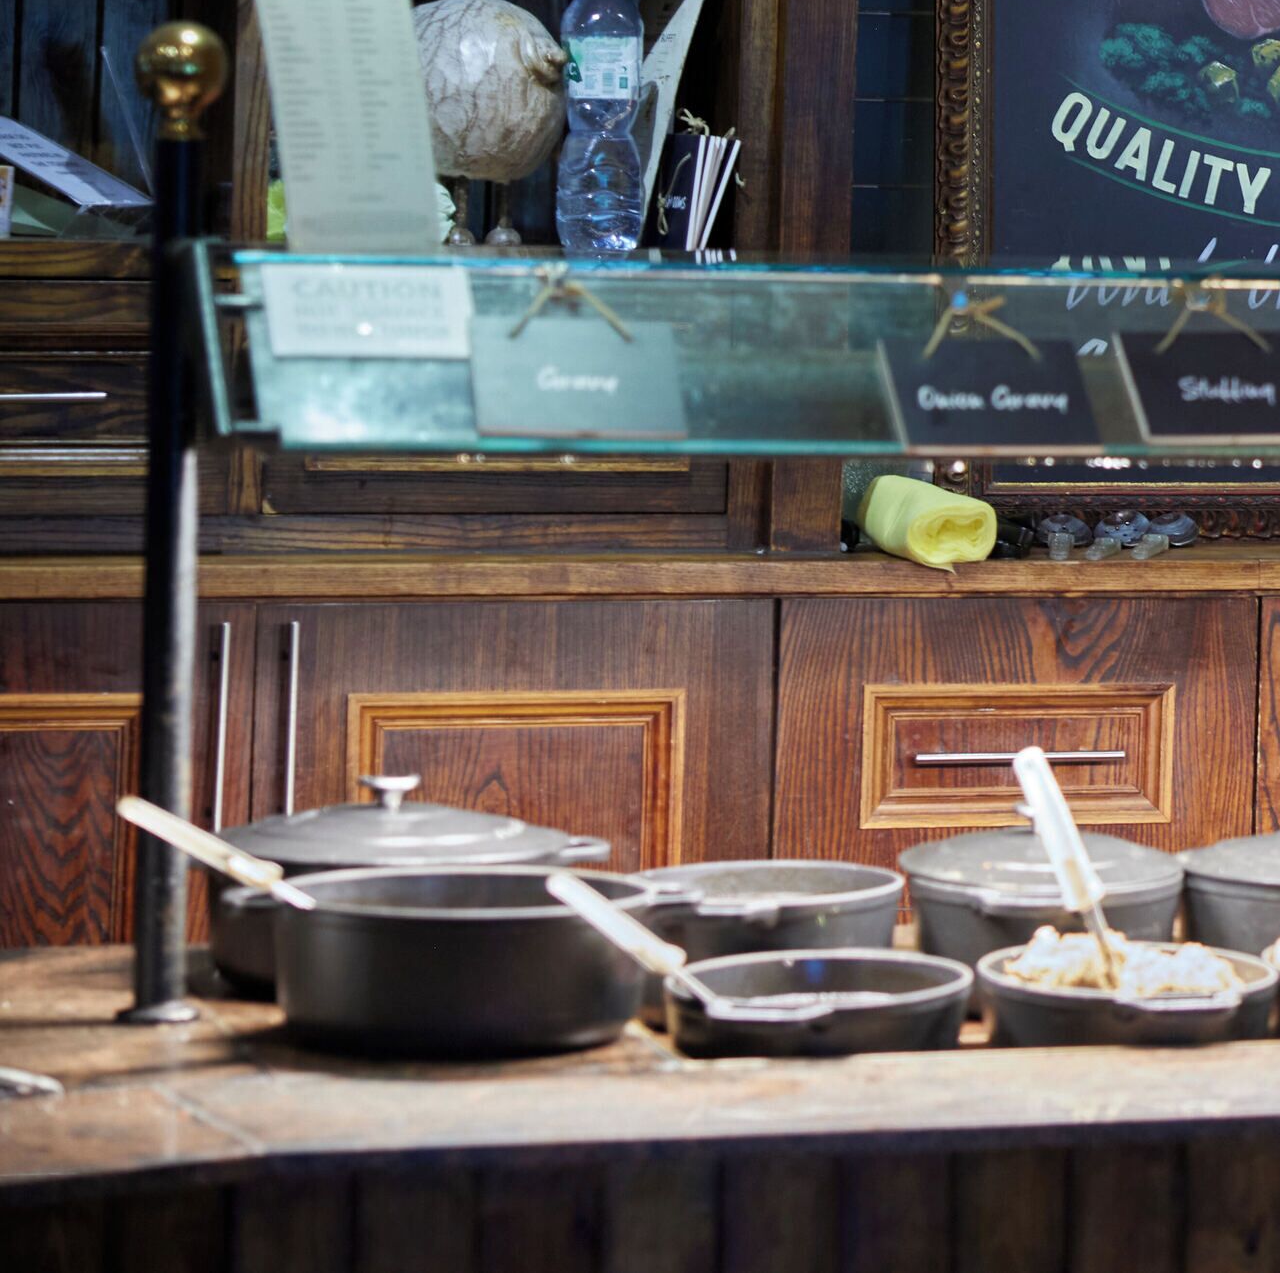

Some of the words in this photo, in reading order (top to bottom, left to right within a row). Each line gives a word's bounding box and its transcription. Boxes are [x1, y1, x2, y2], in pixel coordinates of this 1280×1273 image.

[1051, 92, 1271, 214] QUALITY
[917, 384, 984, 410] Onion
[992, 384, 1068, 415] Gravy
[1178, 375, 1276, 406] Stuffing
